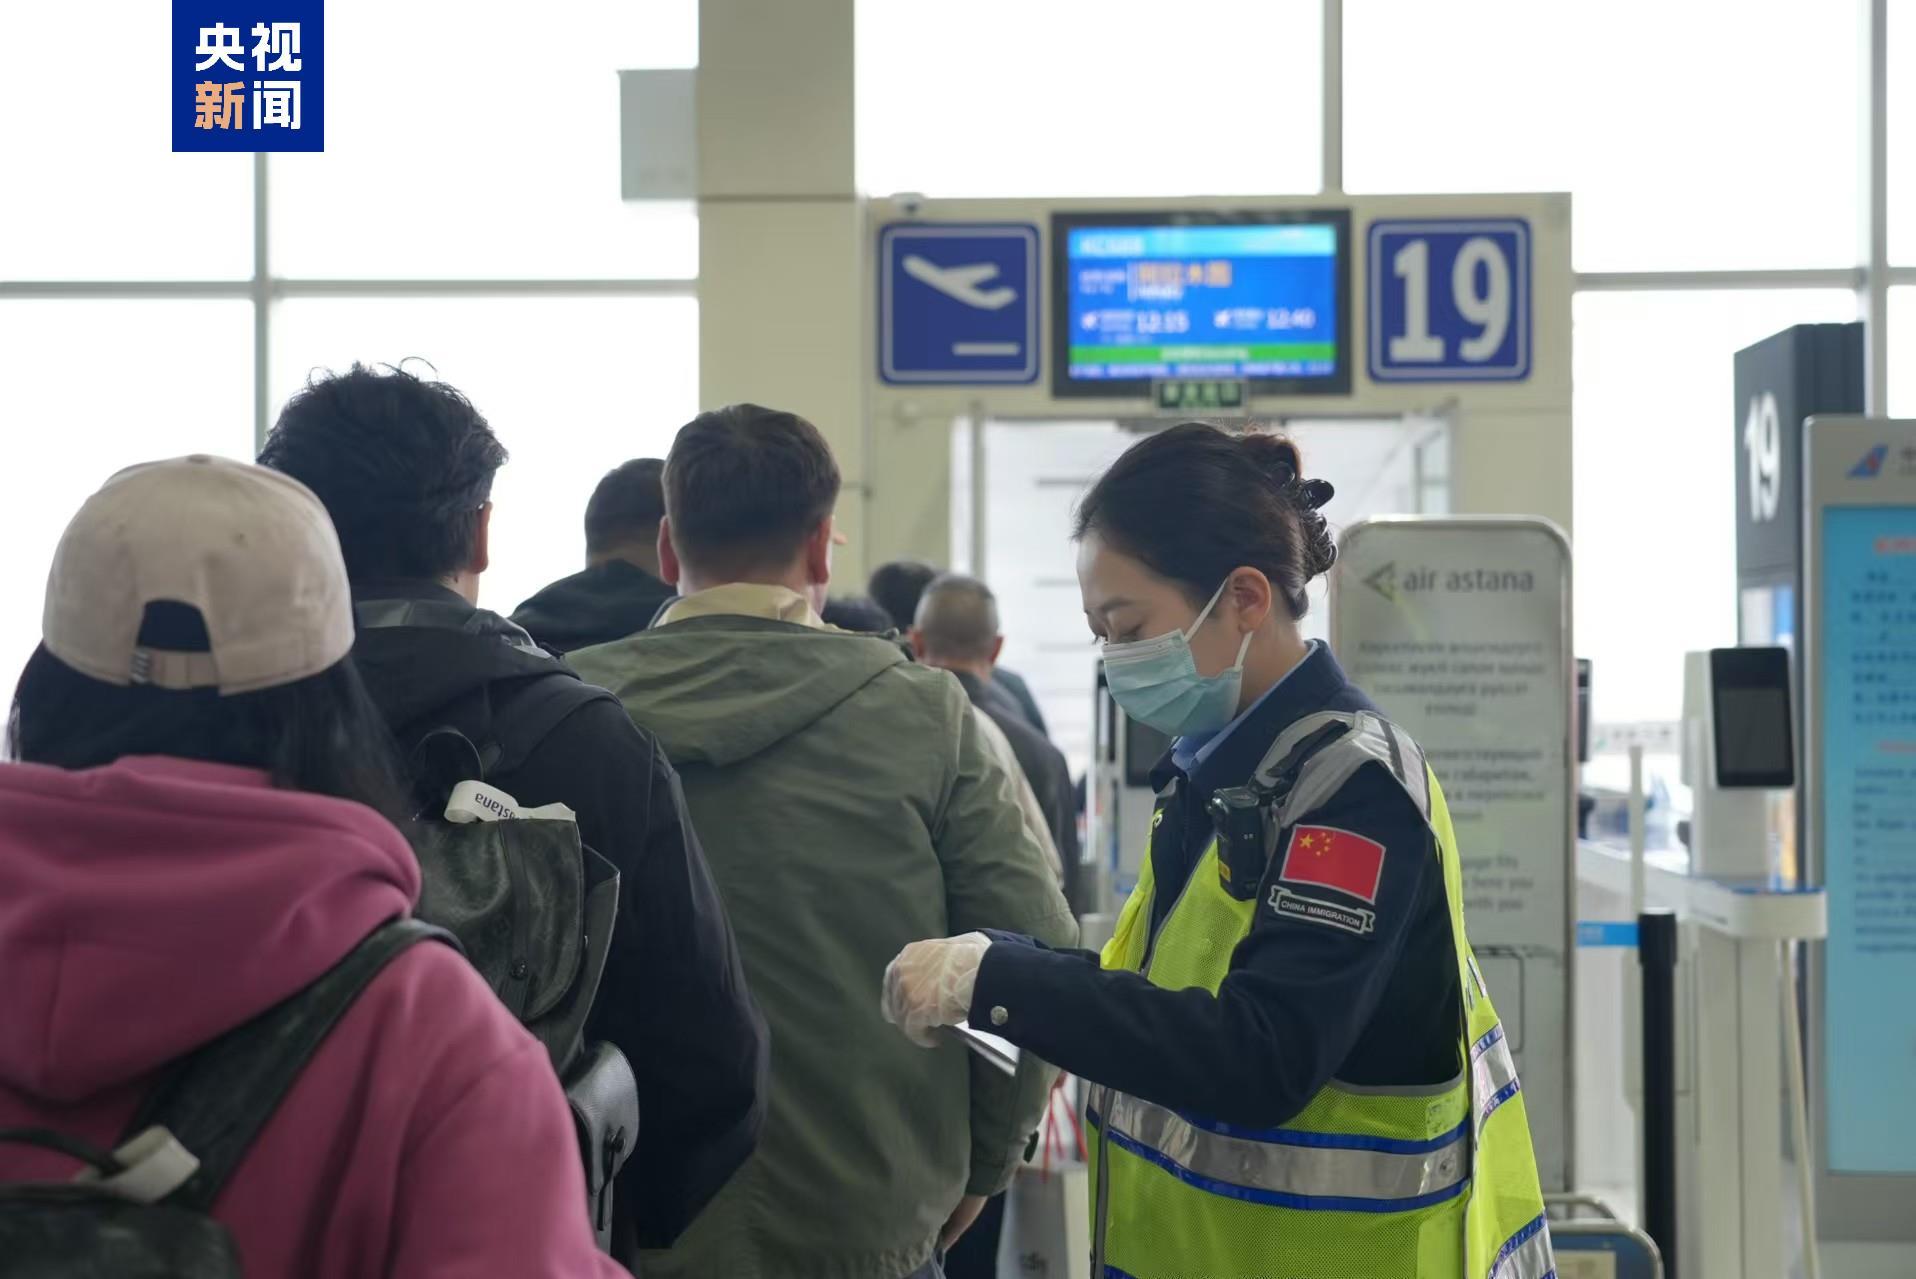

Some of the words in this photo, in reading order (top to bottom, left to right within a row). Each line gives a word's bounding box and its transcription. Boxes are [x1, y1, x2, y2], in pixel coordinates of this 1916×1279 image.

[1388, 236, 1511, 362] 19
[1743, 391, 1781, 523] 19
[1403, 565, 1438, 592] air
[1445, 569, 1534, 592] astana
[1281, 900, 1306, 912] CHINA
[1307, 904, 1361, 927] IMMIGRATION
